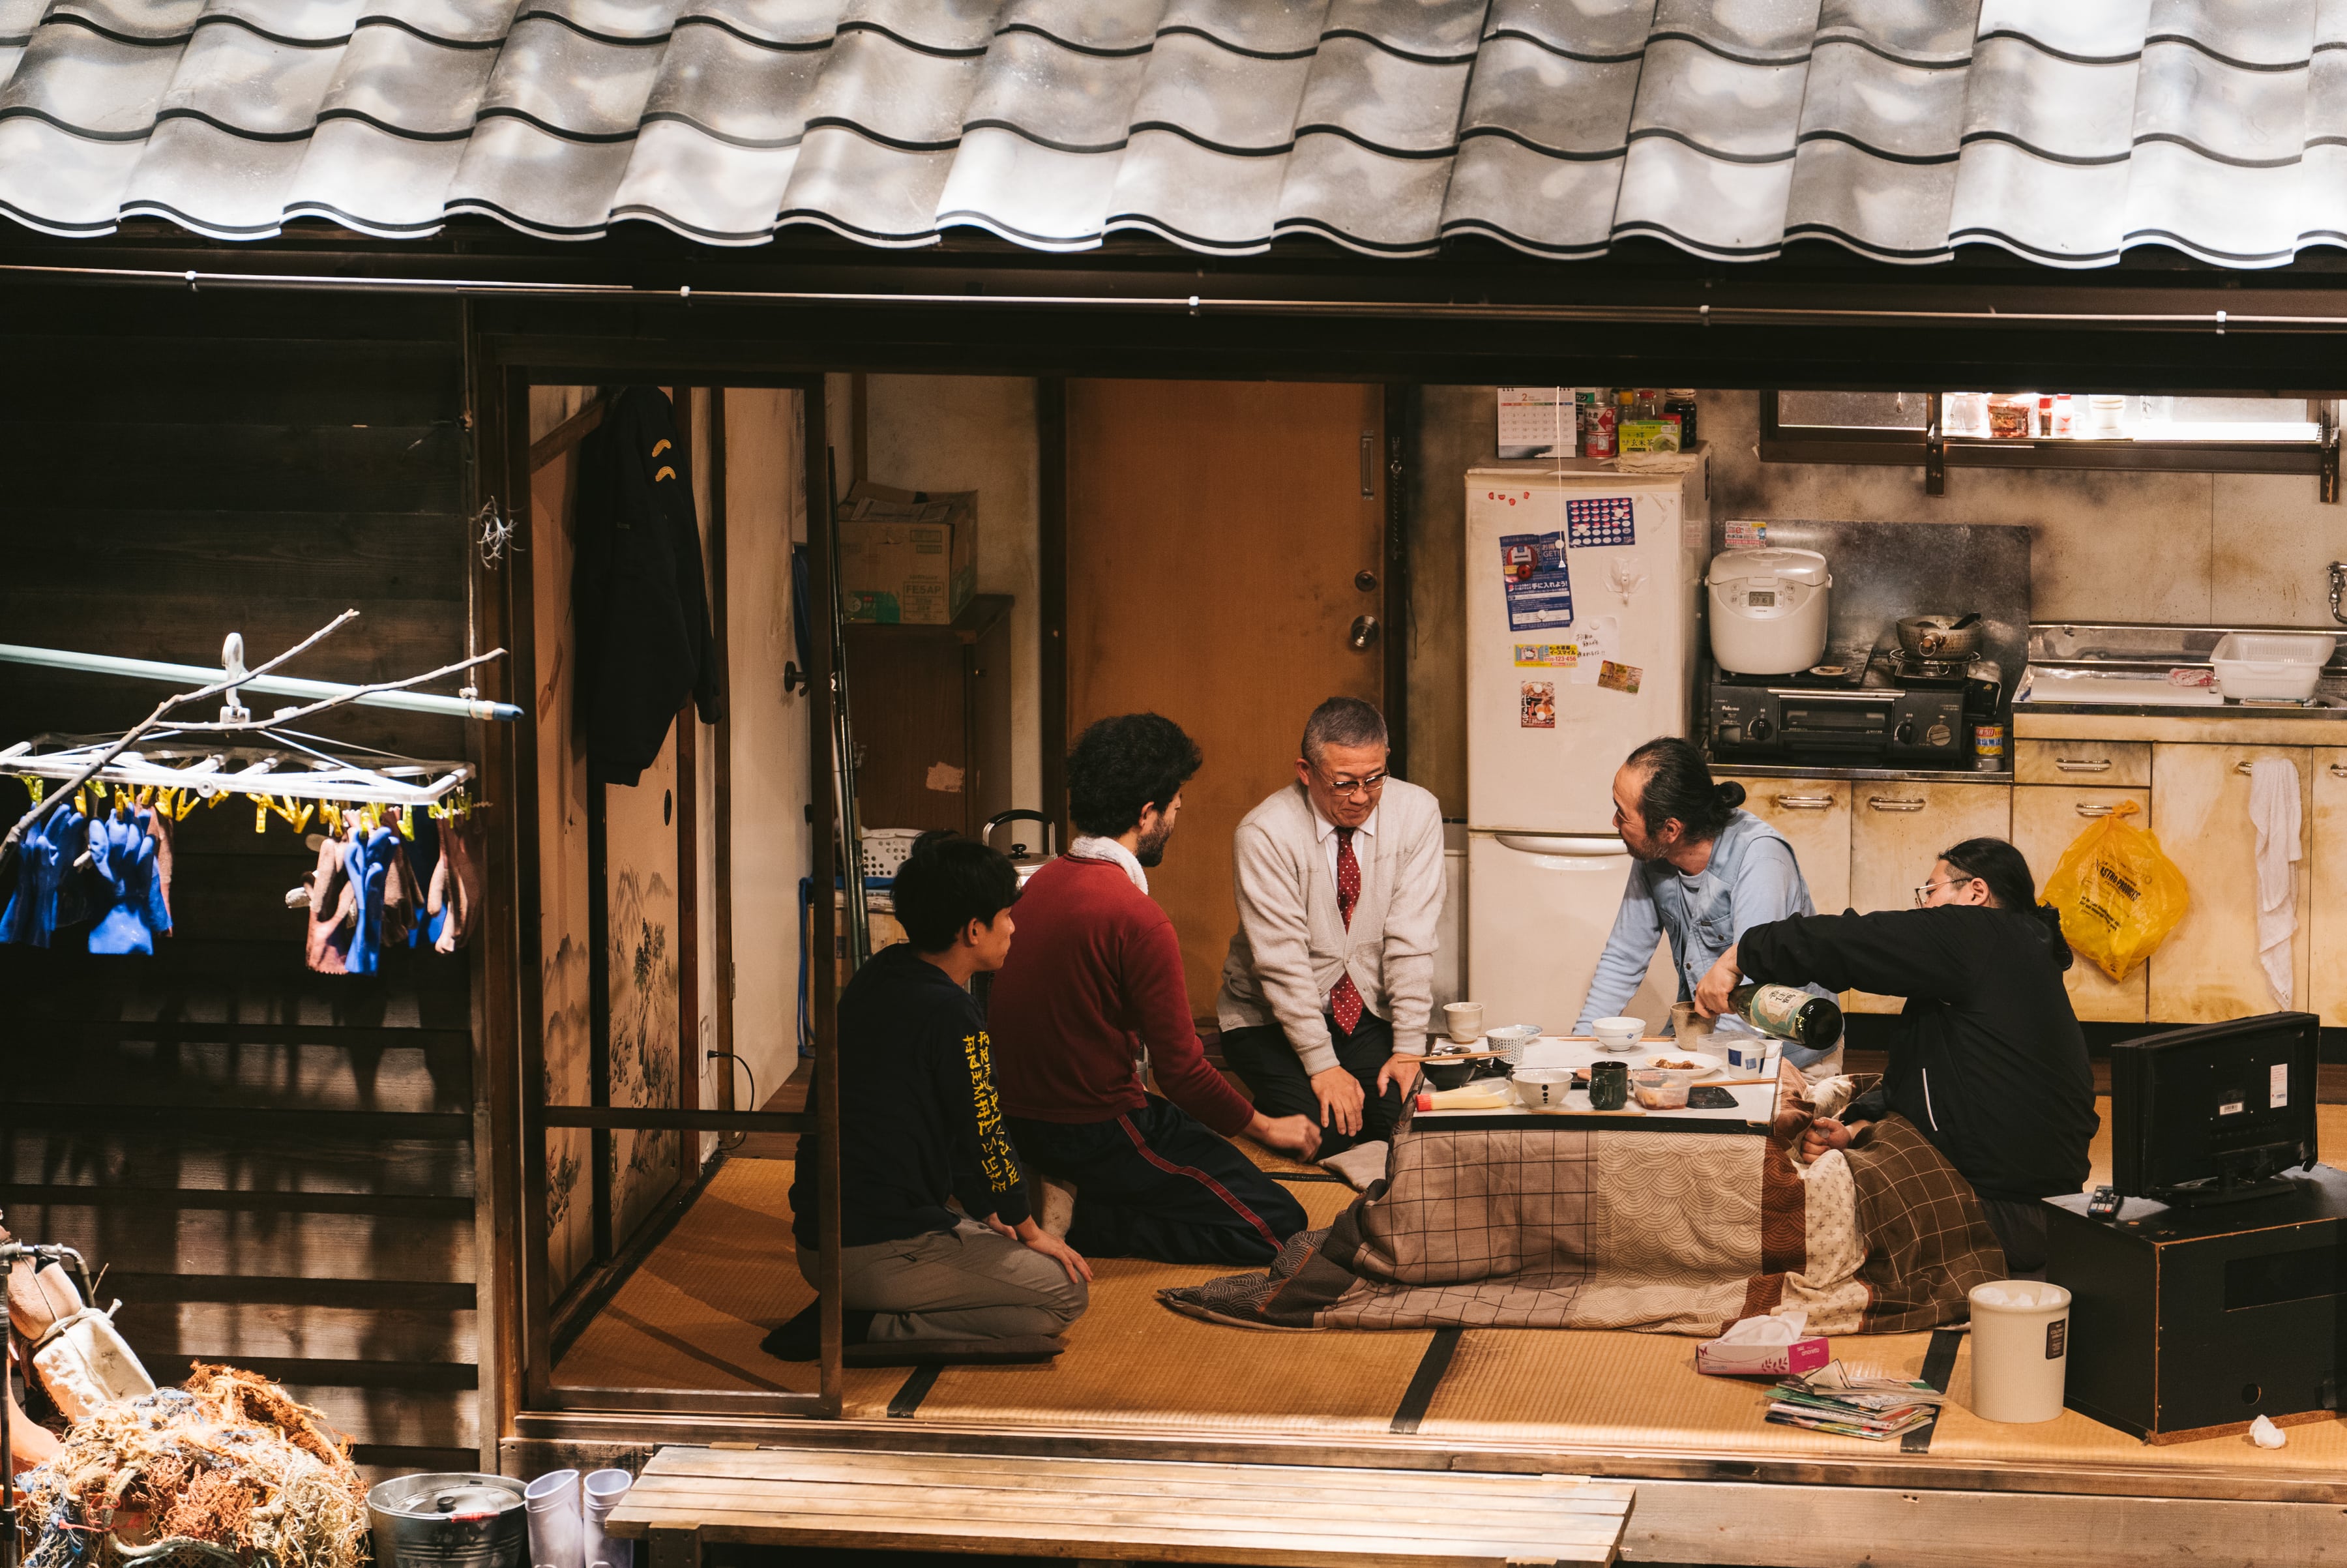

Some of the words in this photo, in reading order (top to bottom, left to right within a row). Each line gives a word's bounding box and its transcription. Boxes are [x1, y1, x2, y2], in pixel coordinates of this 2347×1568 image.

[1531, 580, 1568, 590] 手に入れよう!
